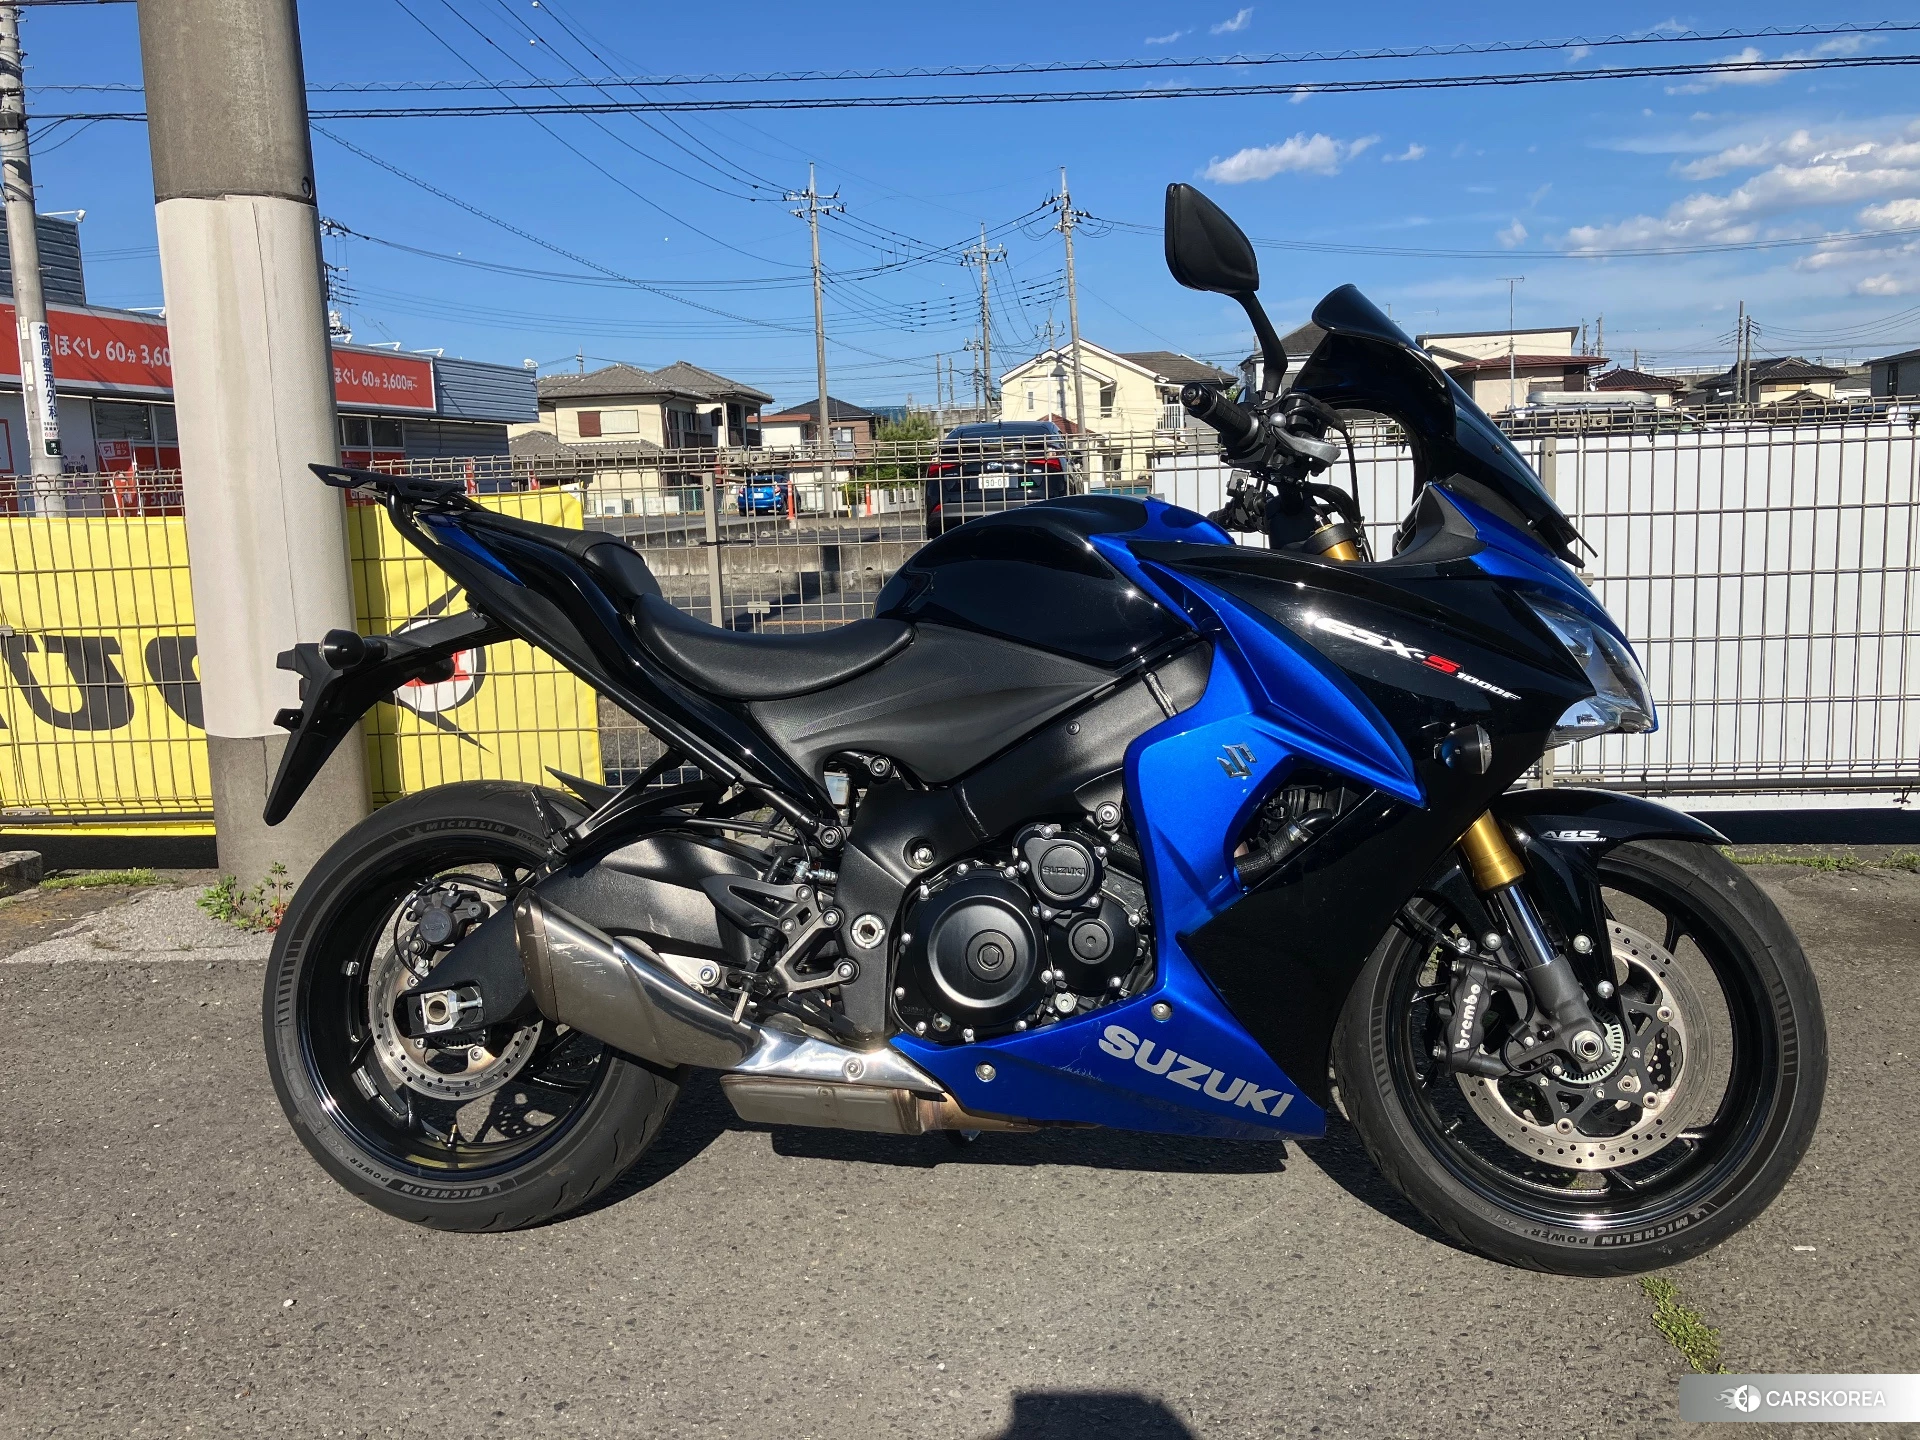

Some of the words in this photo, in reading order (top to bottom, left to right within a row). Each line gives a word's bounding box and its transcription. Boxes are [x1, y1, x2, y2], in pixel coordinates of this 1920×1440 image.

[361, 370, 380, 388] 60分
[425, 819, 507, 833] MICHELIN
[1540, 830, 1602, 841] ABS
[1042, 865, 1086, 877] SUZUKI
[1455, 983, 1481, 1049] brembo
[1098, 1025, 1294, 1117] SUZUKI
[400, 1183, 490, 1199] MICHELIN
[1531, 1228, 1589, 1244] POWER
[1600, 1215, 1689, 1245] MICHELIN
